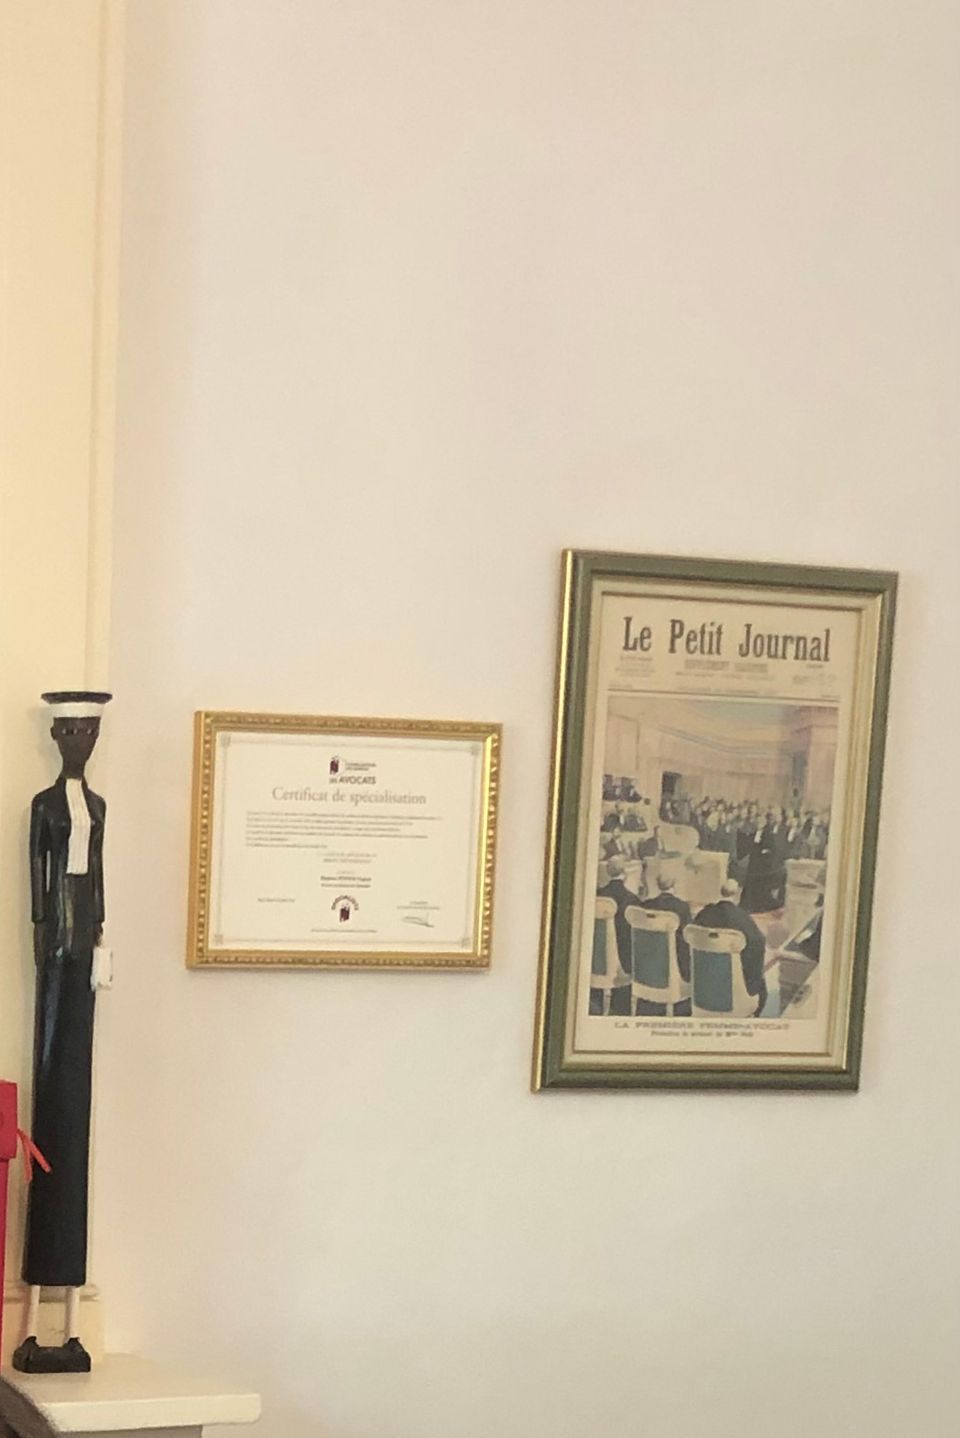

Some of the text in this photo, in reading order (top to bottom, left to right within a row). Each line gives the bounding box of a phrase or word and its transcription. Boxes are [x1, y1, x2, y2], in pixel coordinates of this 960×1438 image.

[622, 616, 831, 662] Le Petit Journal
[272, 787, 427, 806] Certificat de spécialisation
